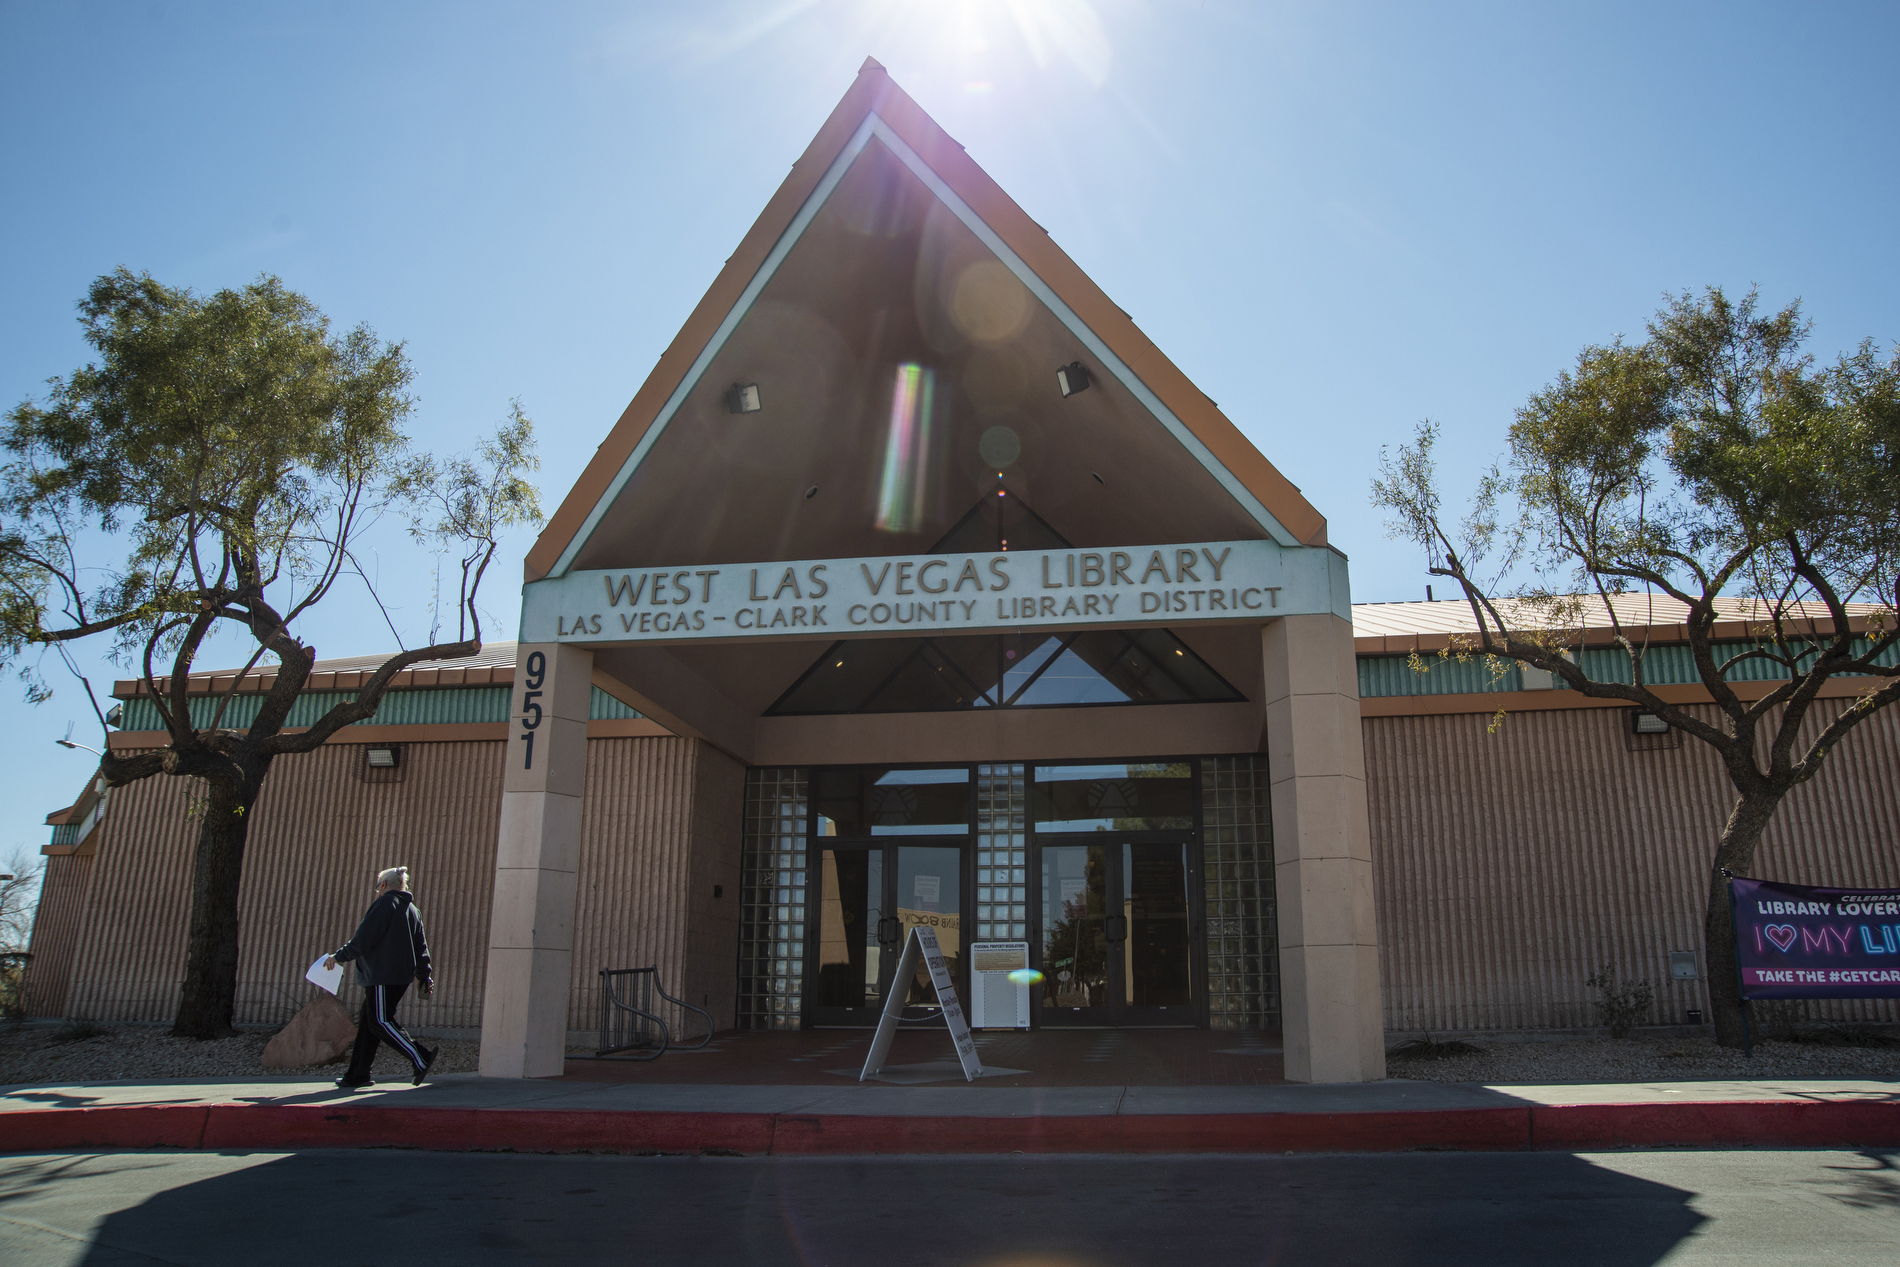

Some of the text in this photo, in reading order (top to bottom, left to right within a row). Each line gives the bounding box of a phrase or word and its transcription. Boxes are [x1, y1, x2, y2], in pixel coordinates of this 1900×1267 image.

[604, 547, 1231, 607] WEST LAS VEGAS LIBRARY
[557, 613, 602, 636] LAS
[847, 599, 976, 625] COUNTY
[998, 593, 1119, 620] LIBRARY
[1140, 586, 1283, 613] DISTRICT
[521, 651, 546, 770] 951
[1758, 901, 1900, 915] LIBRARY LOVER
[1756, 926, 1762, 951] I
[1802, 926, 1852, 953] MY
[1756, 971, 1794, 982] TAKE
[1796, 971, 1826, 982] THE
